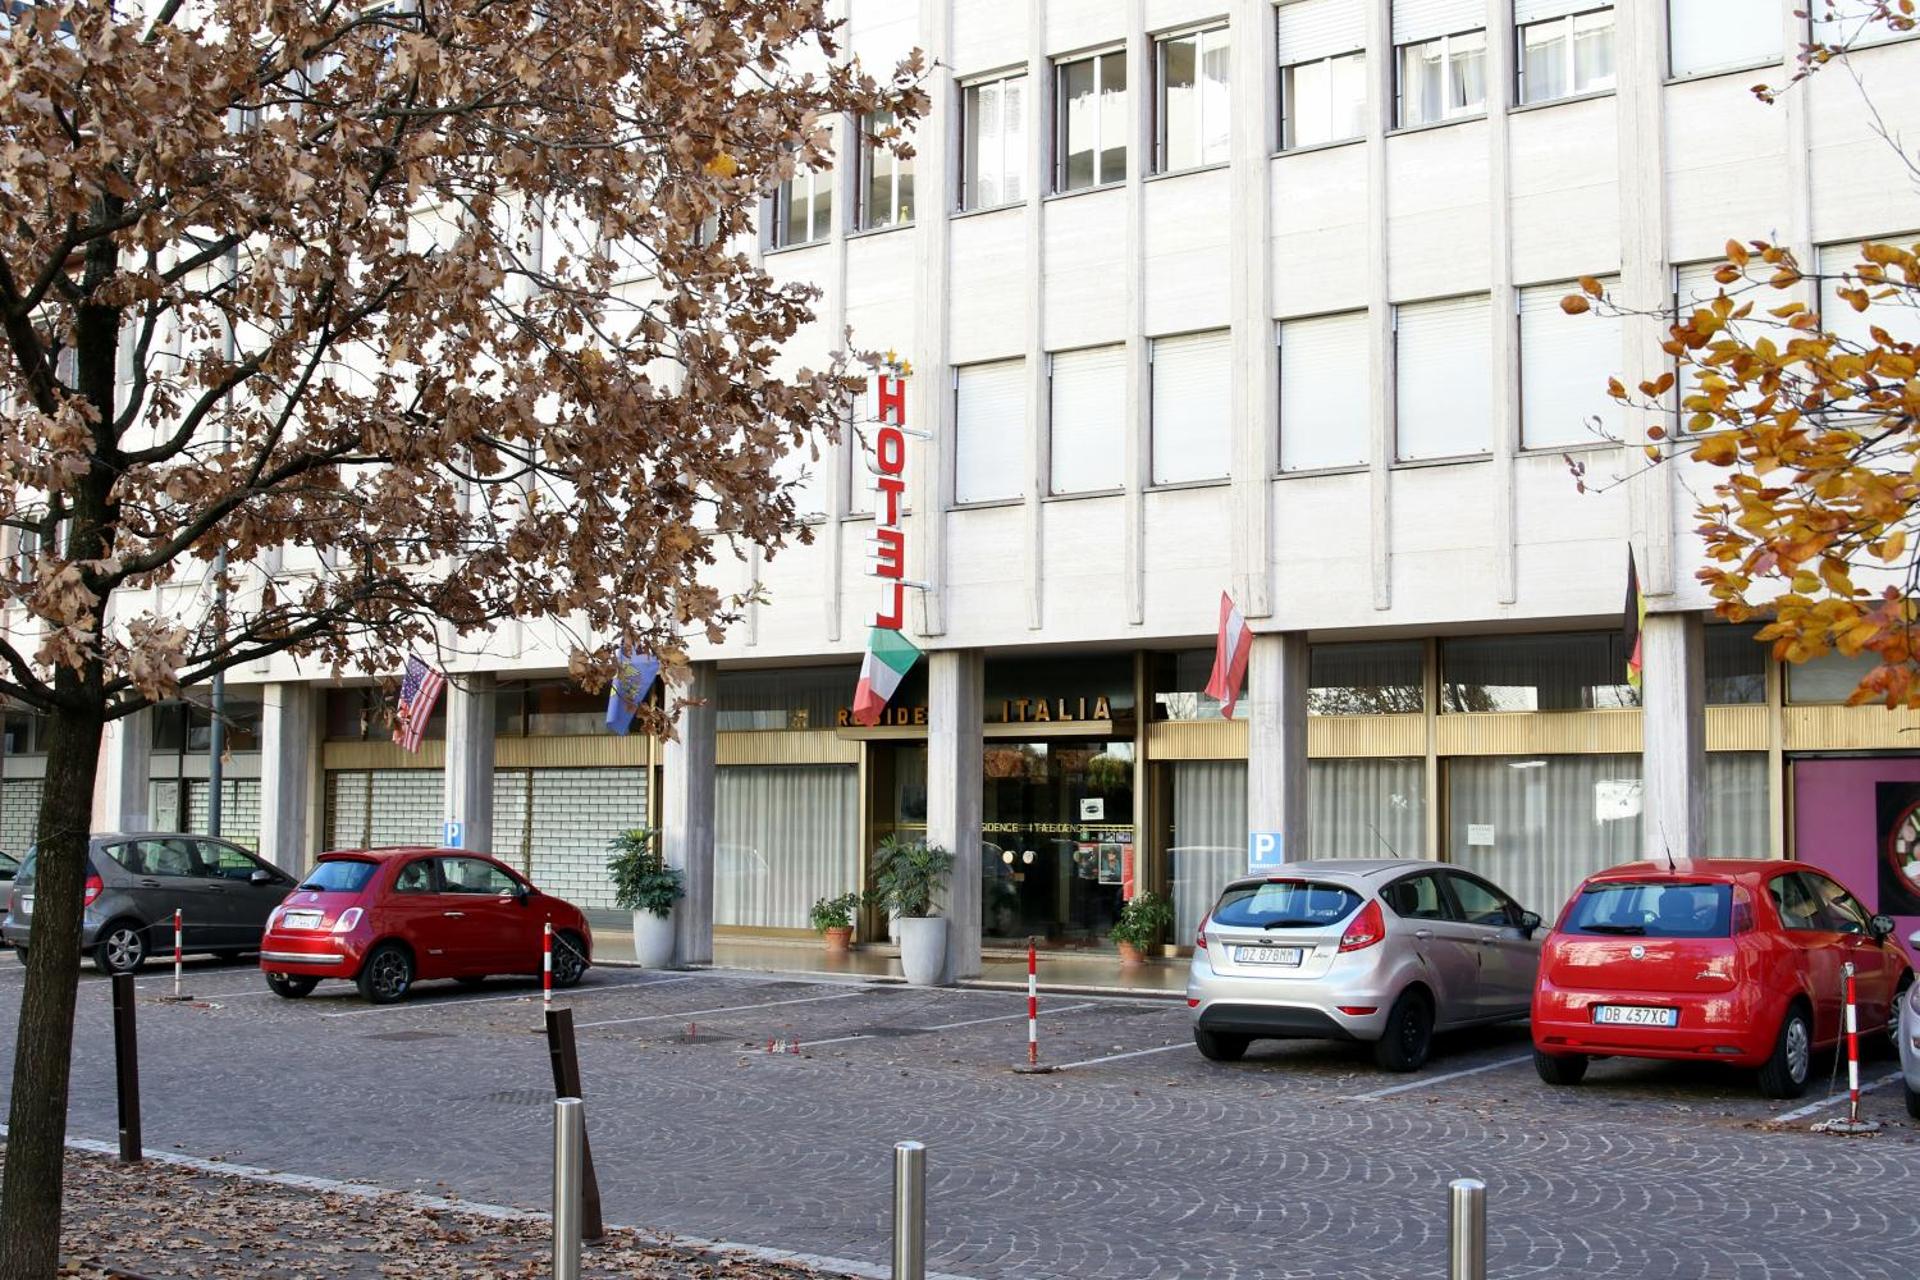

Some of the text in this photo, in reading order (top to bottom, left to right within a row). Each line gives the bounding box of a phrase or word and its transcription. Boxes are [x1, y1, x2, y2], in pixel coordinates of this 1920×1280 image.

[1002, 697, 1111, 722] ITALIA
[1256, 834, 1275, 861] P
[1605, 1007, 1668, 1023] DB 437XC
